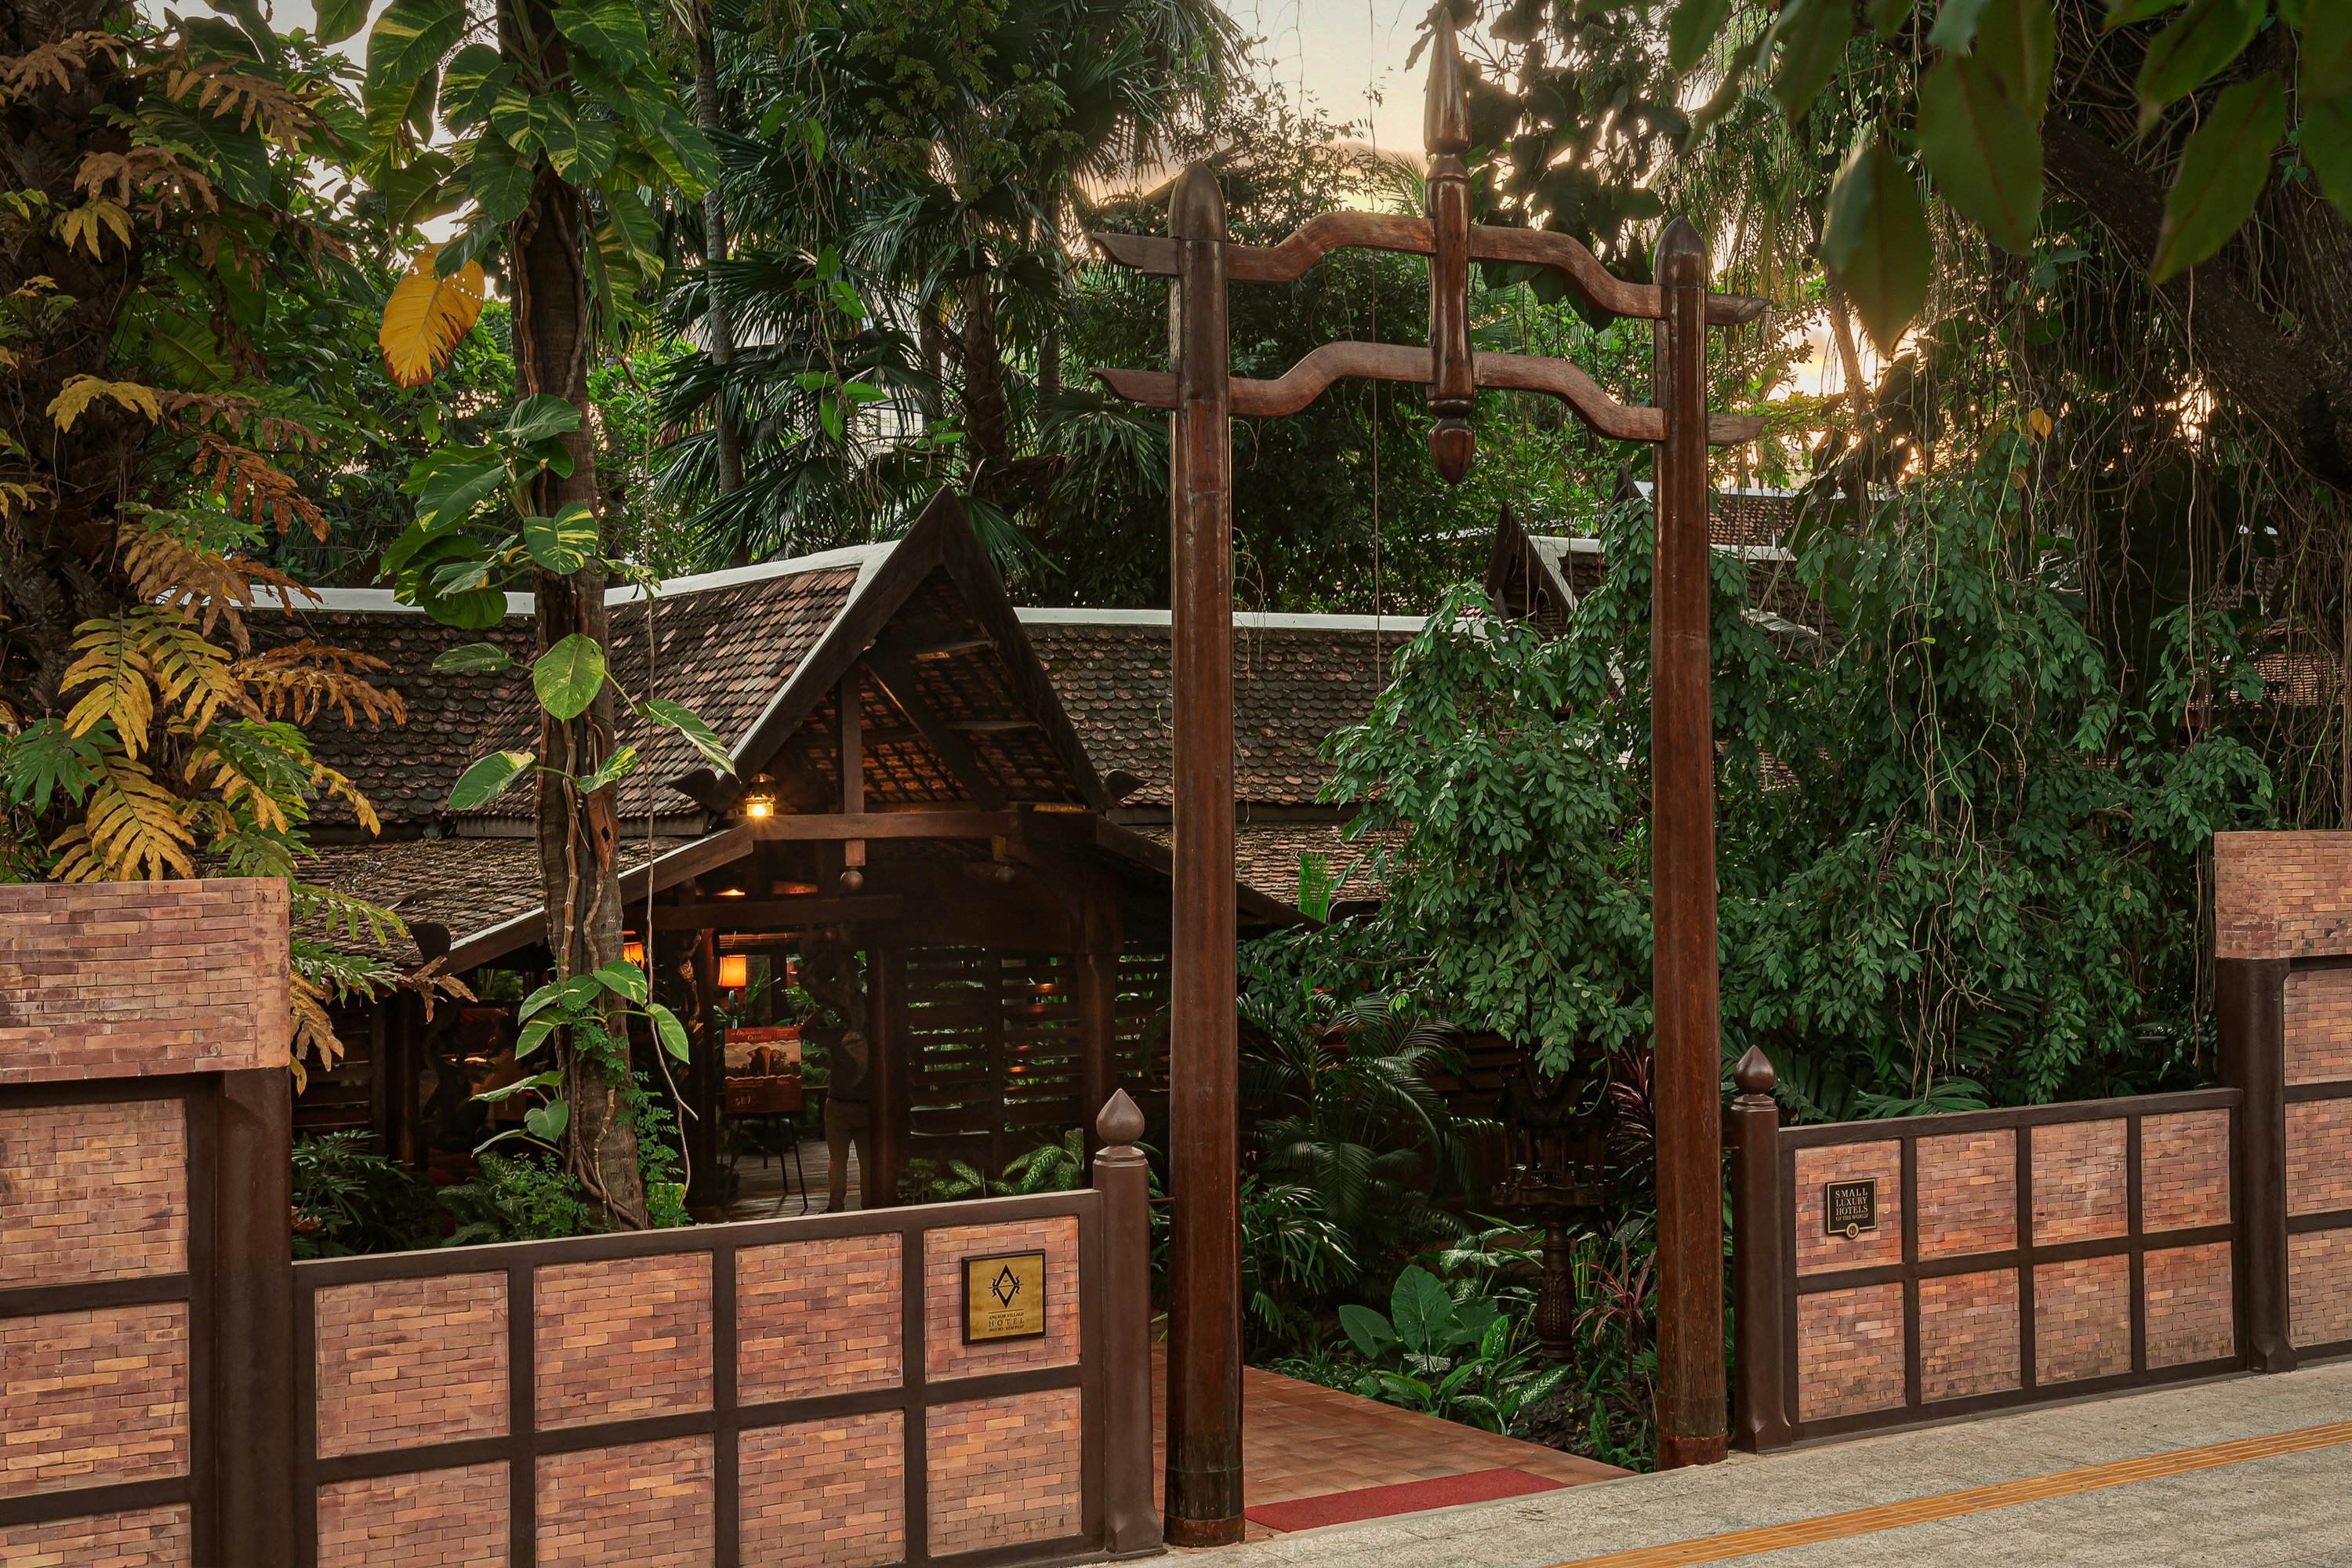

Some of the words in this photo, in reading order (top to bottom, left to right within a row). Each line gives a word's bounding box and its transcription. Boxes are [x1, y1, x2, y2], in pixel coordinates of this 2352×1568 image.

[1835, 1188, 1867, 1199] SMALL
[1836, 1196, 1867, 1207] LUXURY
[1836, 1205, 1868, 1216] HOTELS
[989, 1317, 1024, 1327] HOTEL
